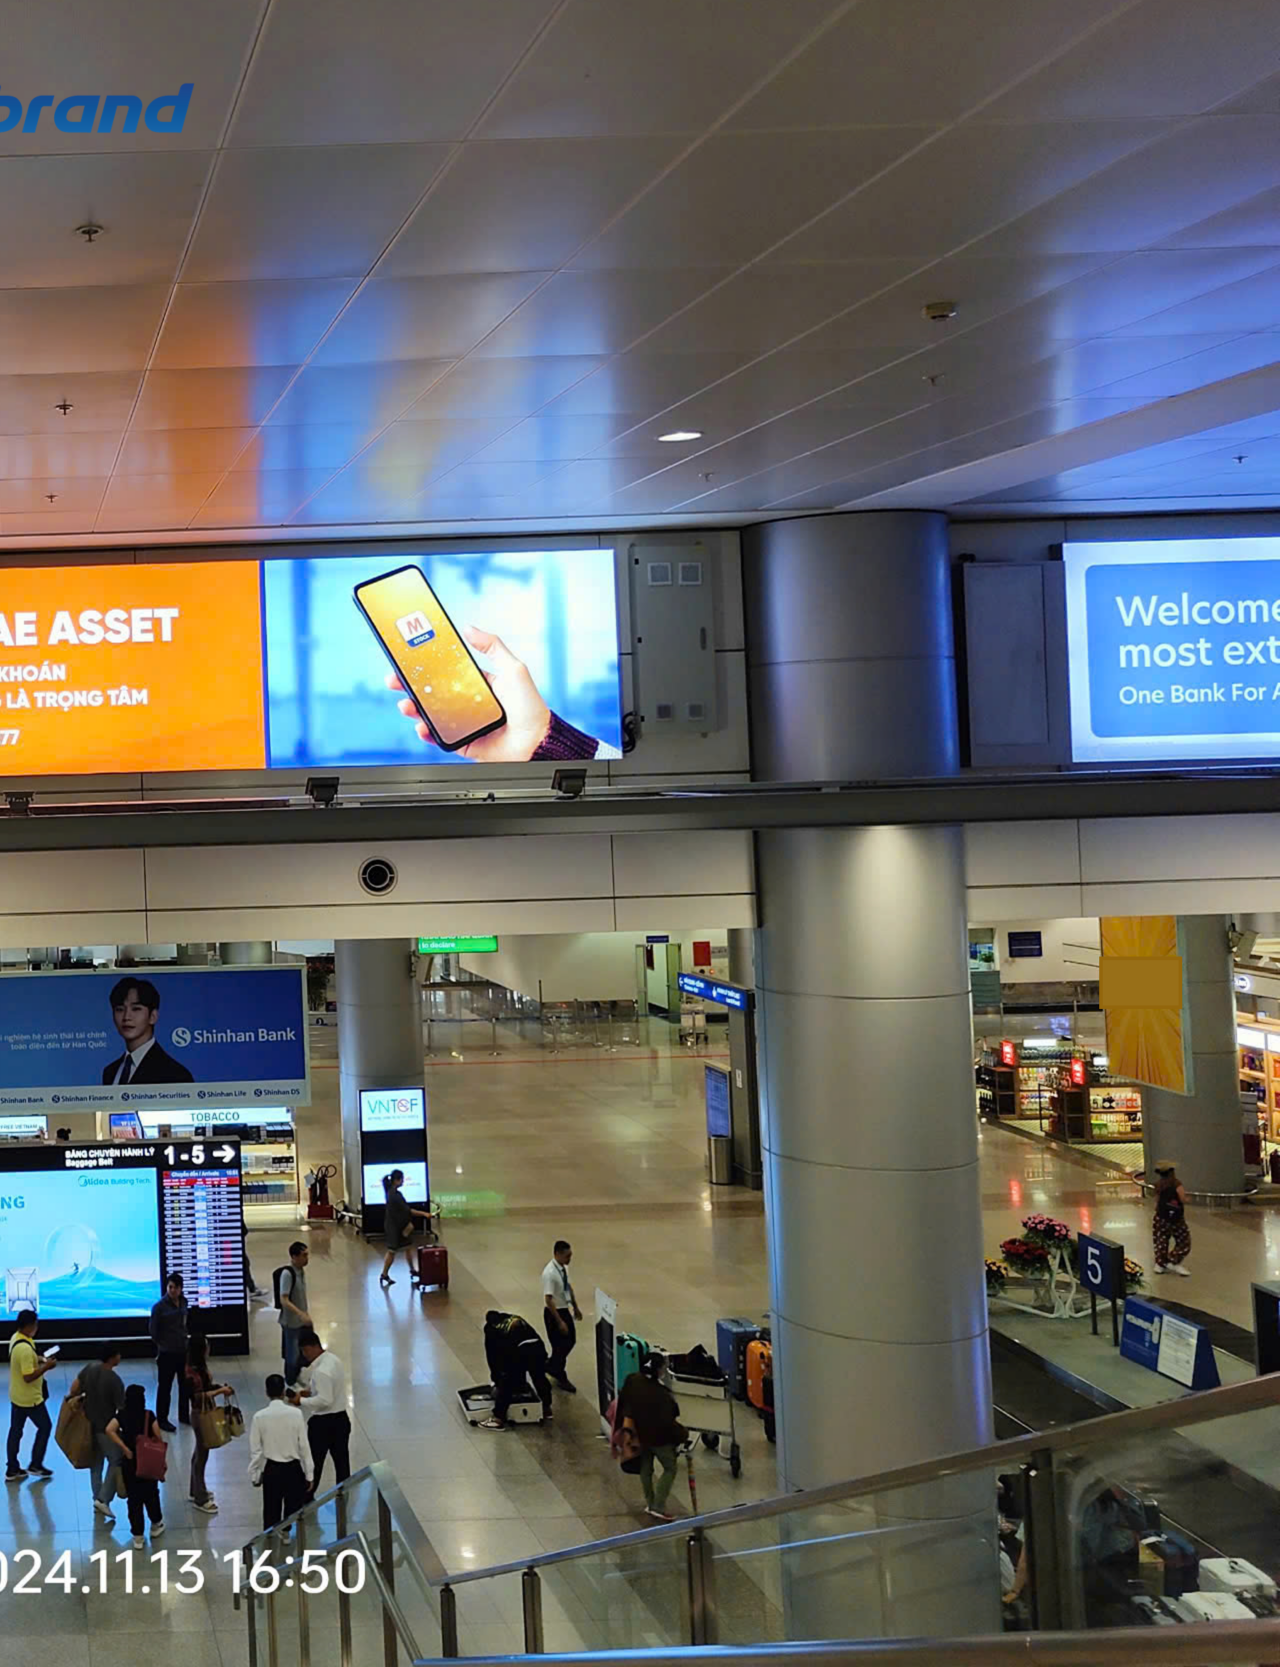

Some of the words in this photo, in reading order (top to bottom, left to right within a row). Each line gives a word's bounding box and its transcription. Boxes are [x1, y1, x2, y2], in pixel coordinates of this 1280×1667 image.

[47, 607, 179, 646] ASSET
[1119, 637, 1213, 668] most
[6, 688, 31, 709] LÀ
[33, 689, 104, 712] TRỌNG
[107, 685, 149, 707] TÂM
[1119, 686, 1165, 706] One
[1170, 682, 1226, 704] Bank
[1231, 683, 1267, 702] For
[193, 1029, 255, 1044] Shinhan
[258, 1027, 297, 1042] Bank
[130, 1092, 157, 1100] Shinhan
[158, 1091, 191, 1100] Securities
[206, 1090, 233, 1098] Shinhan
[234, 1089, 247, 1098] Life
[263, 1088, 289, 1096] Shinhan
[290, 1088, 301, 1096] DS
[0, 1096, 27, 1105] Shinhan
[61, 1094, 88, 1103] Shinhan
[88, 1094, 114, 1102] Finance
[189, 1111, 240, 1122] TOBACCO
[65, 1158, 98, 1169] Baggage
[98, 1157, 114, 1167] Belt
[1086, 1246, 1103, 1286] 5
